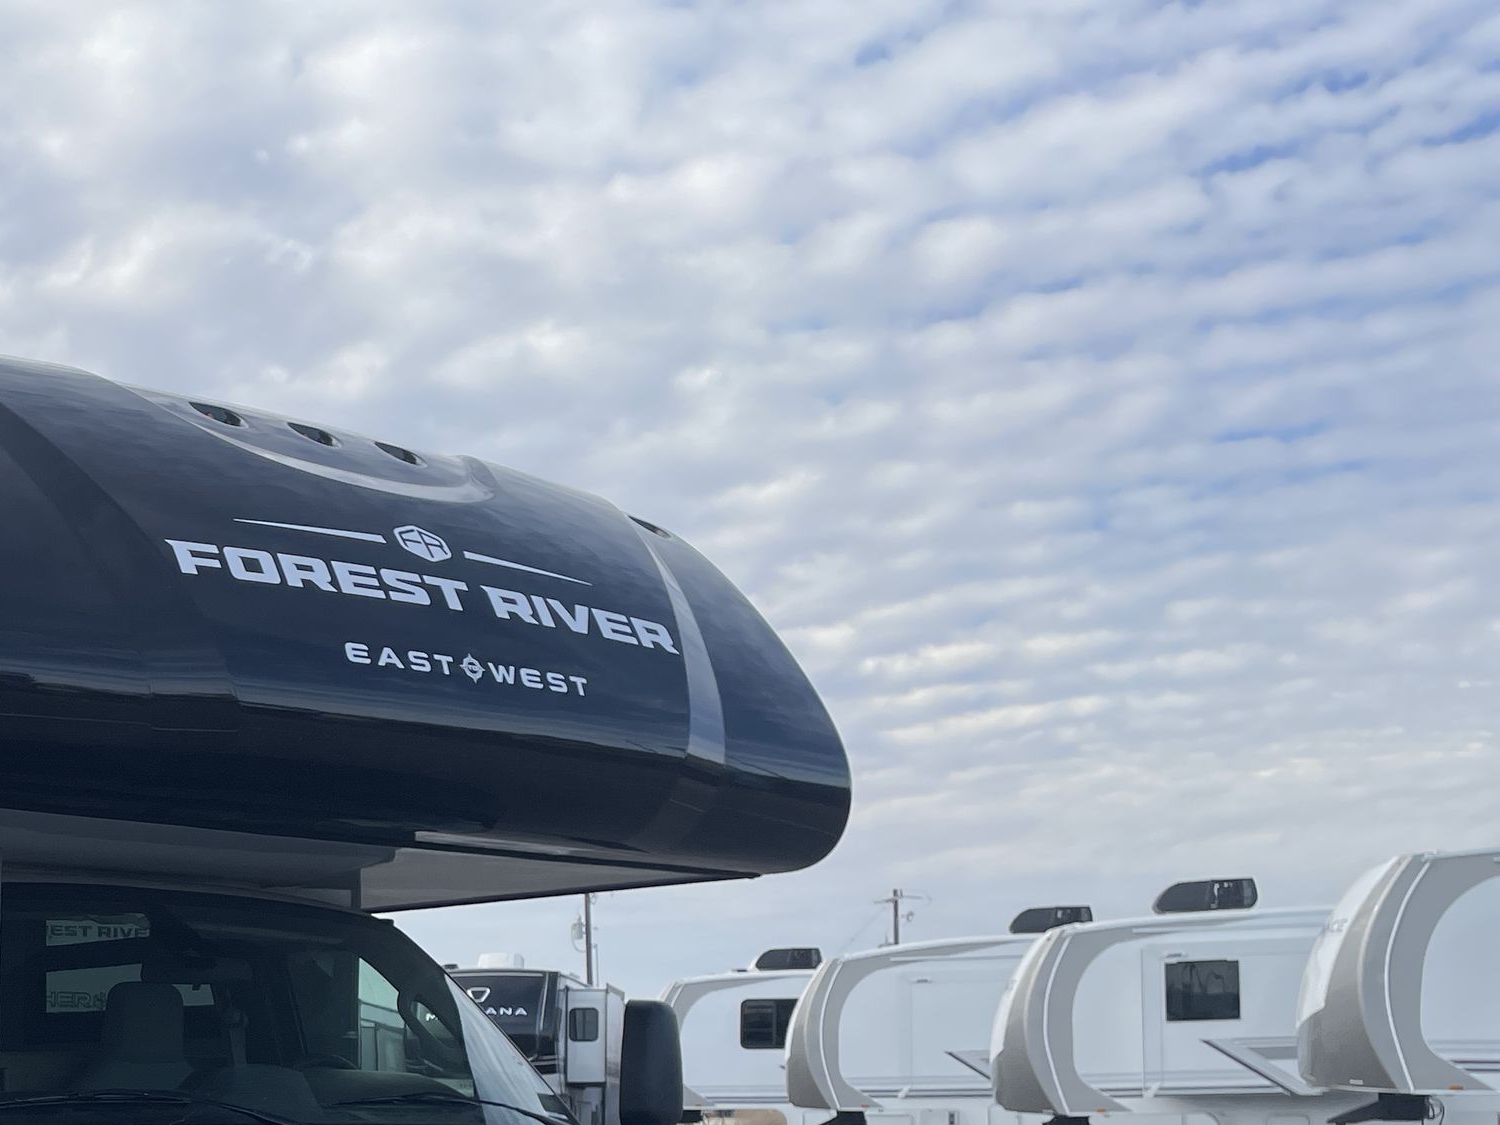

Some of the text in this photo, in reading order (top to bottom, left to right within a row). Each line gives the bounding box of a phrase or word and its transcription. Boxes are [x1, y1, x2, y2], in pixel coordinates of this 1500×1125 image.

[165, 539, 680, 655] FOREST RIVER
[344, 641, 454, 676] EAST
[487, 661, 588, 696] WEST
